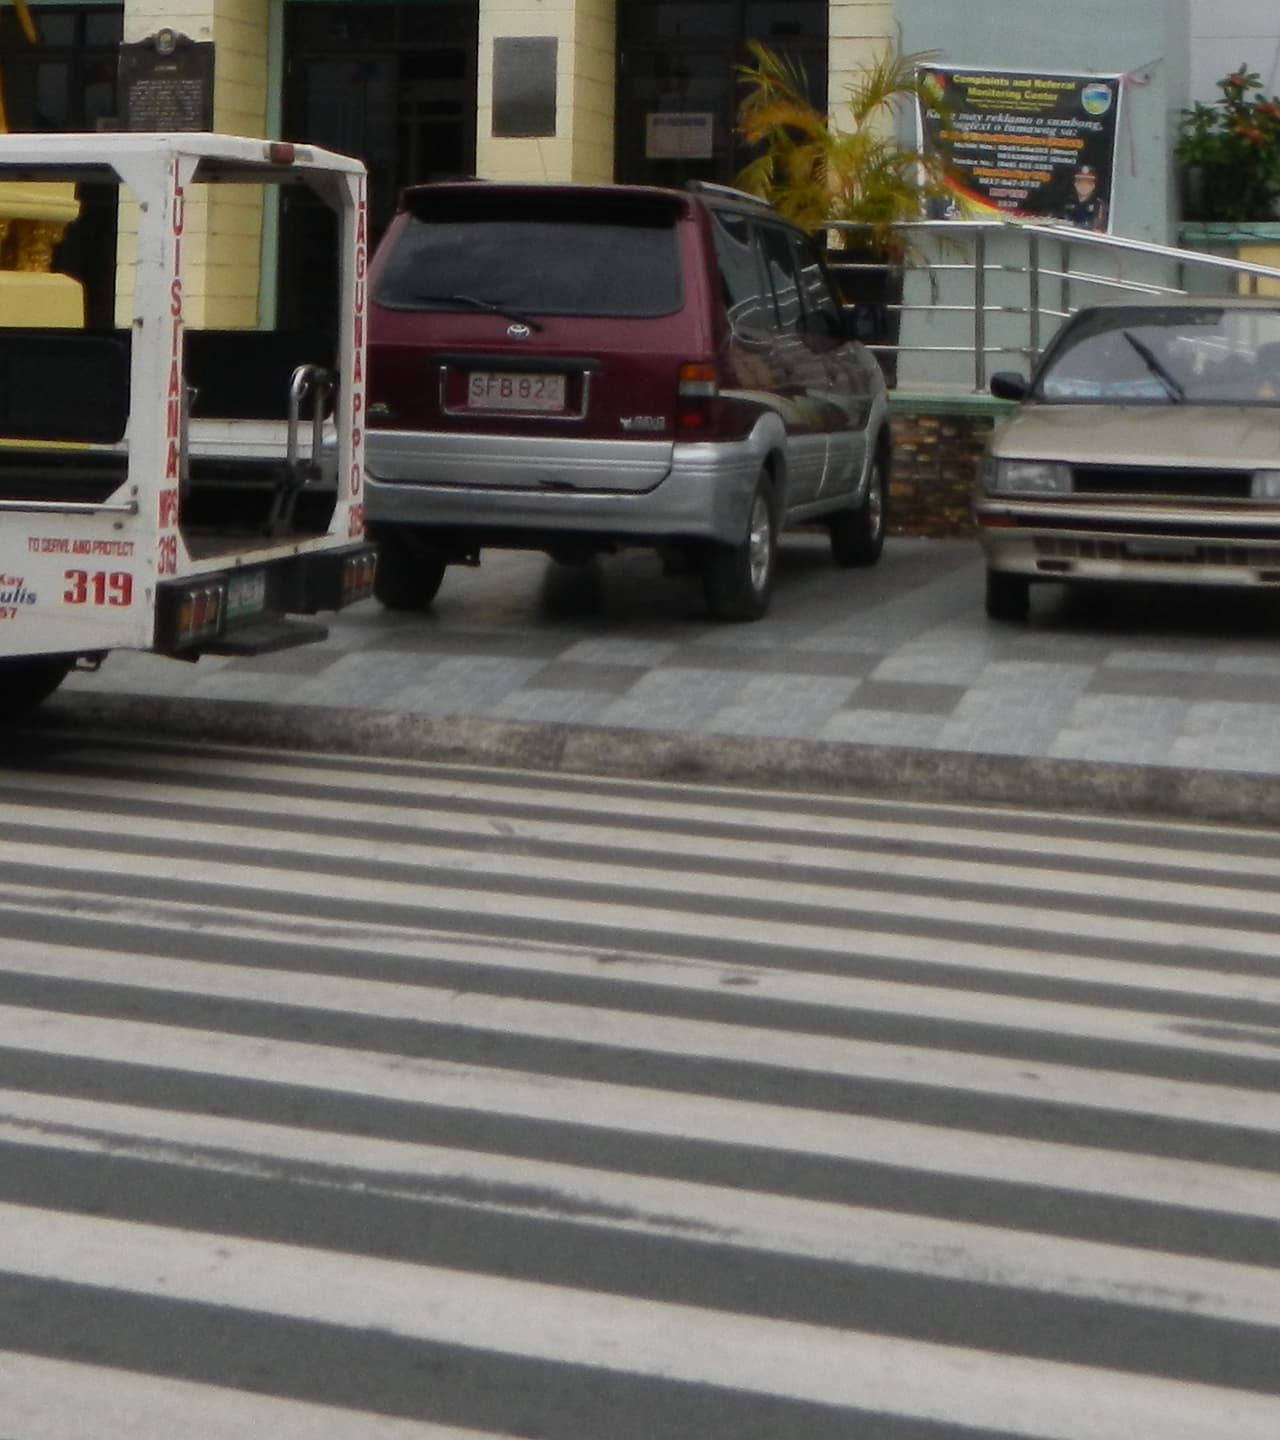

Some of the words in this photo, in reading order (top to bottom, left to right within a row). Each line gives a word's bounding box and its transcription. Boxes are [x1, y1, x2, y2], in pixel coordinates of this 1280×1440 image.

[28, 537, 40, 552] TO
[41, 538, 69, 553] SERVE
[73, 540, 91, 554] AND
[92, 541, 134, 556] PROTECT
[157, 534, 177, 575] 319
[63, 569, 133, 607] 319
